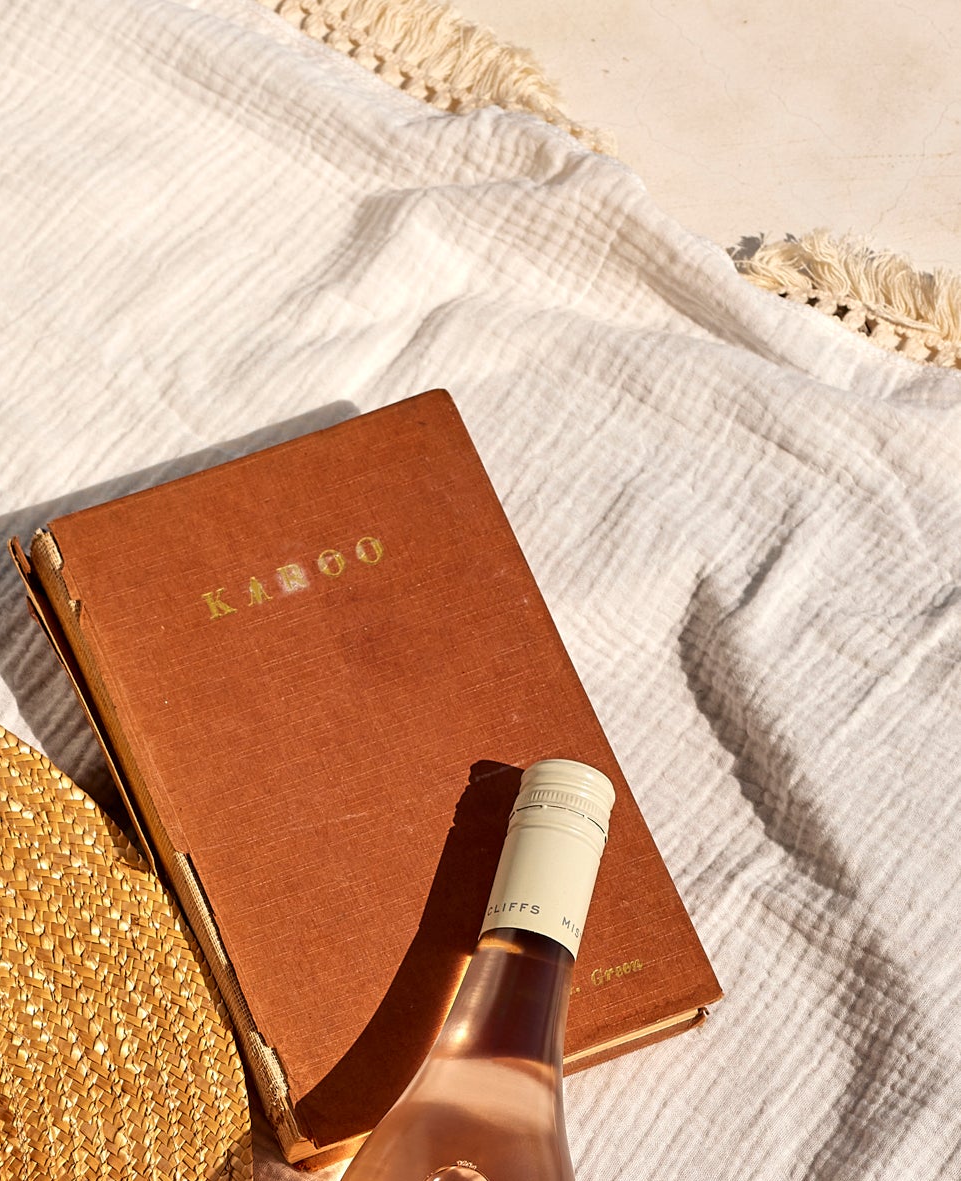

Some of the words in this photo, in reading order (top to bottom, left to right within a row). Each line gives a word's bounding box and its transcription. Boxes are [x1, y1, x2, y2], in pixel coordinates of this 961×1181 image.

[201, 536, 384, 620] KAROO
[487, 902, 540, 917] CLIFFS
[562, 916, 582, 938] MIS
[591, 958, 643, 986] Green
